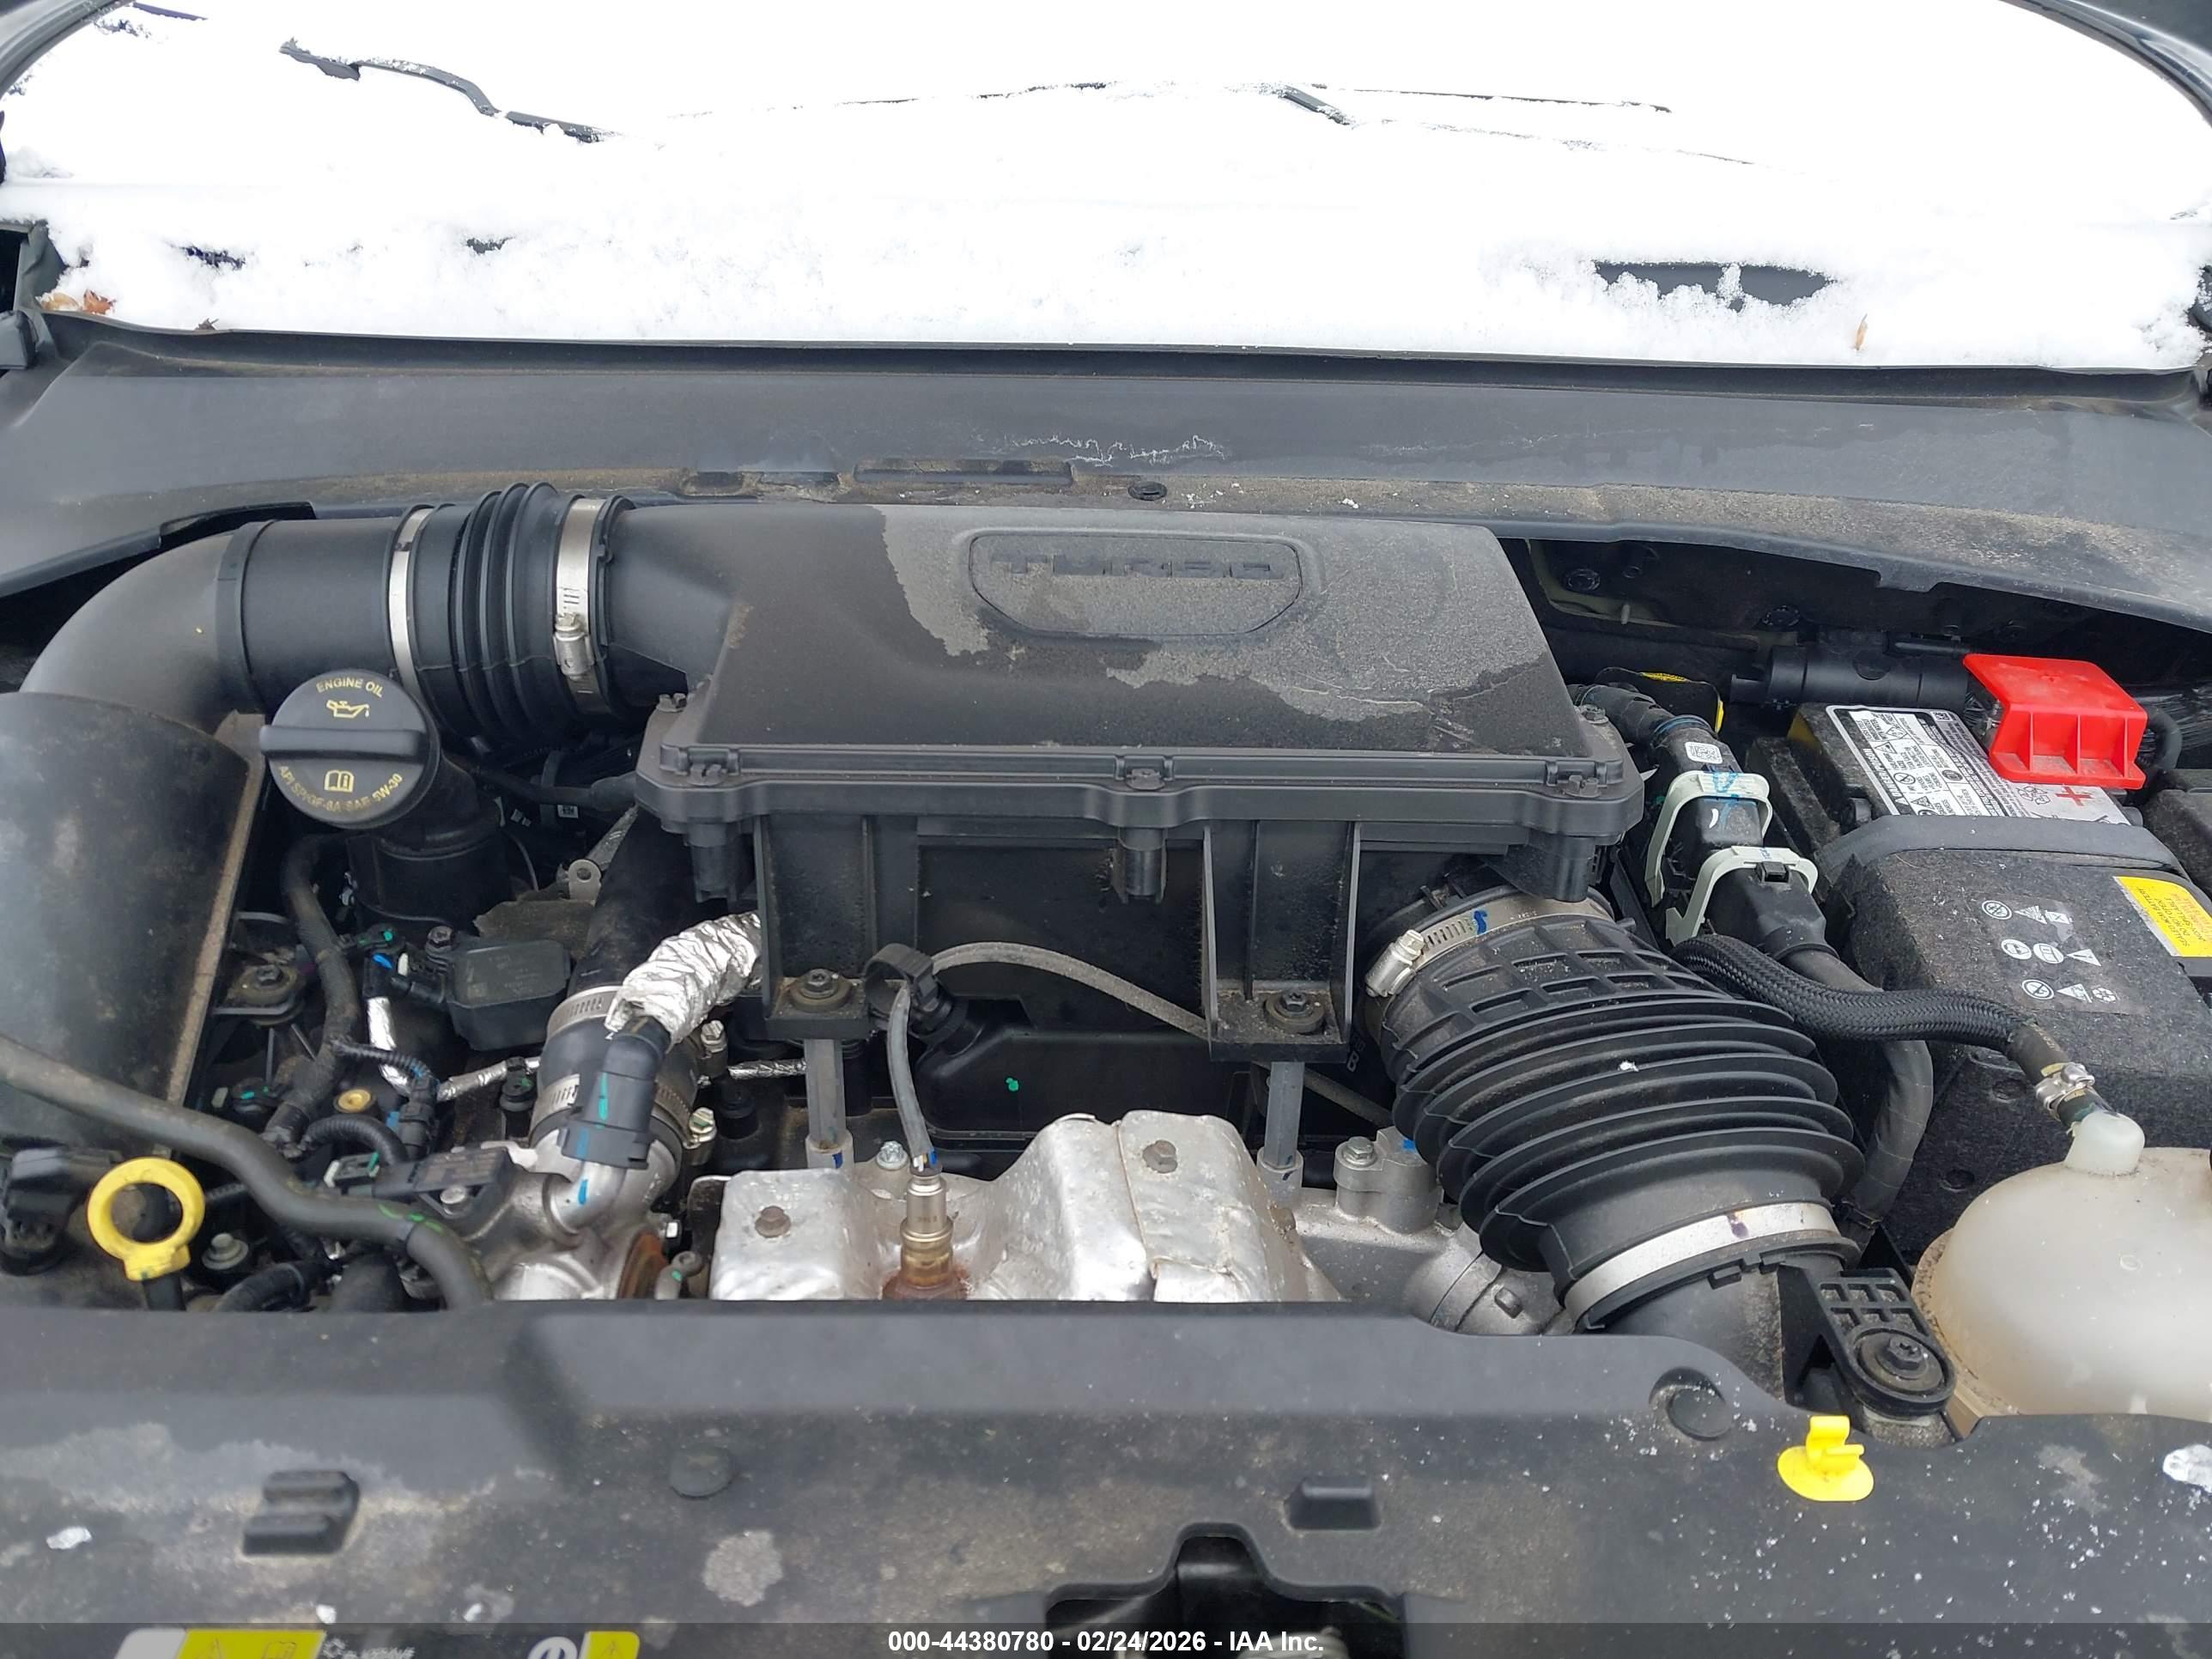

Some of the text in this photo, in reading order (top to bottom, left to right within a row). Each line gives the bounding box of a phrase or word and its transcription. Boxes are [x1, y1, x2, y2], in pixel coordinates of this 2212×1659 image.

[316, 677, 383, 697] ENGINE OIL
[280, 767, 295, 785] API
[372, 773, 403, 801] 5W-30
[1861, 748, 1903, 797] DANGER/POISON
[2136, 888, 2160, 909] BATTERY
